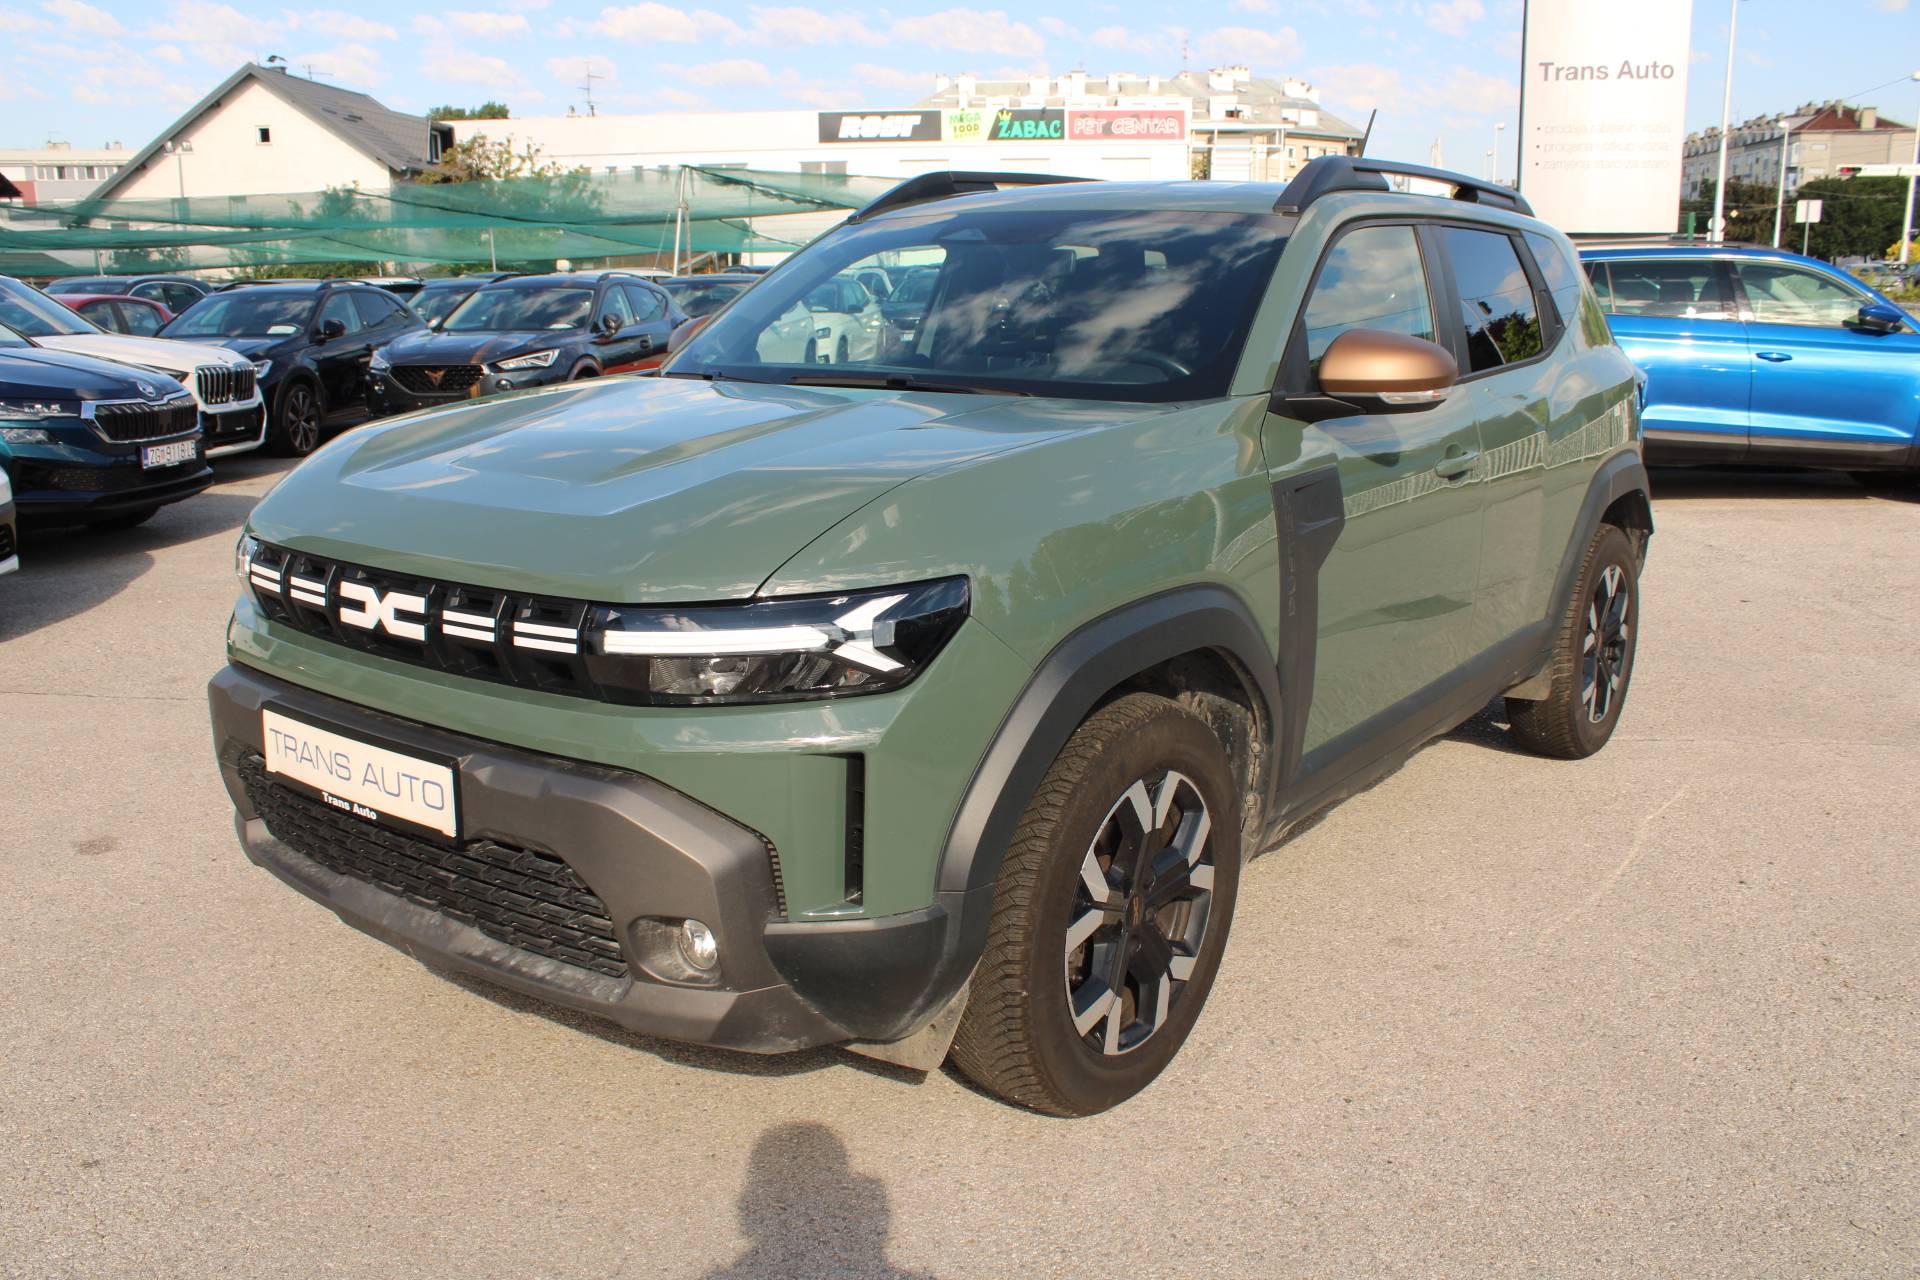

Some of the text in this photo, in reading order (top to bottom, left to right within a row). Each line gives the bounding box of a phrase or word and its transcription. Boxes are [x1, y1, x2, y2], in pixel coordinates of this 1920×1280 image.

[1538, 60, 1675, 82] Trans Auto
[1073, 117, 1180, 136] PET CENTAR
[269, 728, 445, 811] TRANS AUTO
[322, 791, 377, 821] Trans Auto
